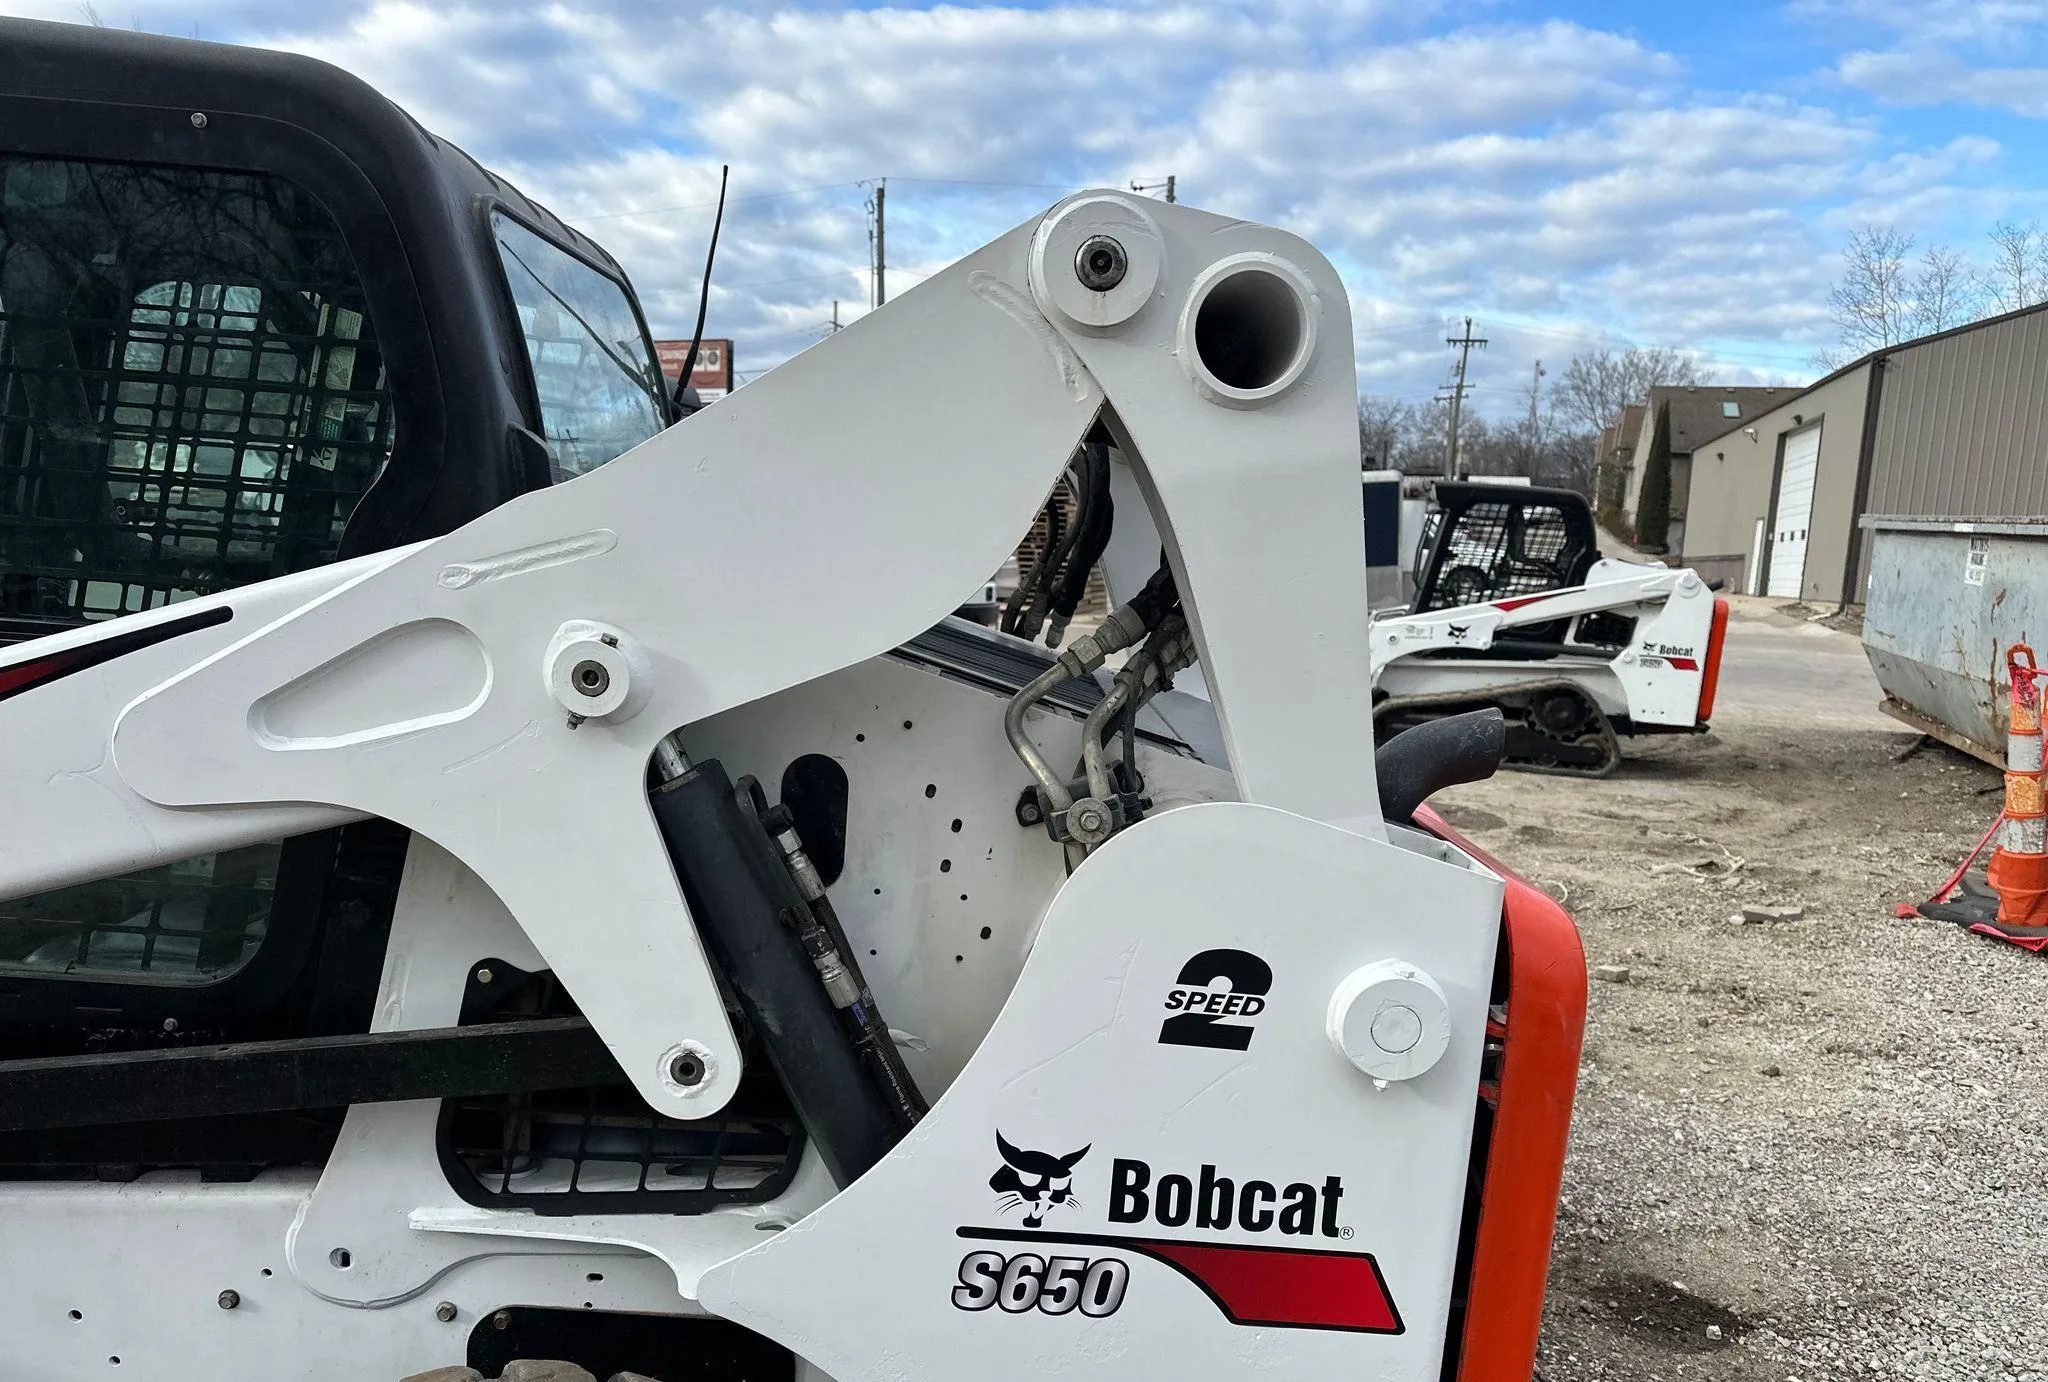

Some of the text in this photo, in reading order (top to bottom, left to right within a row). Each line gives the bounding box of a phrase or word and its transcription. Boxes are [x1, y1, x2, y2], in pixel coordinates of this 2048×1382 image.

[1158, 949, 1273, 1051] 2
[1164, 989, 1266, 1017] SPEED
[951, 1250, 1130, 1318] S650
